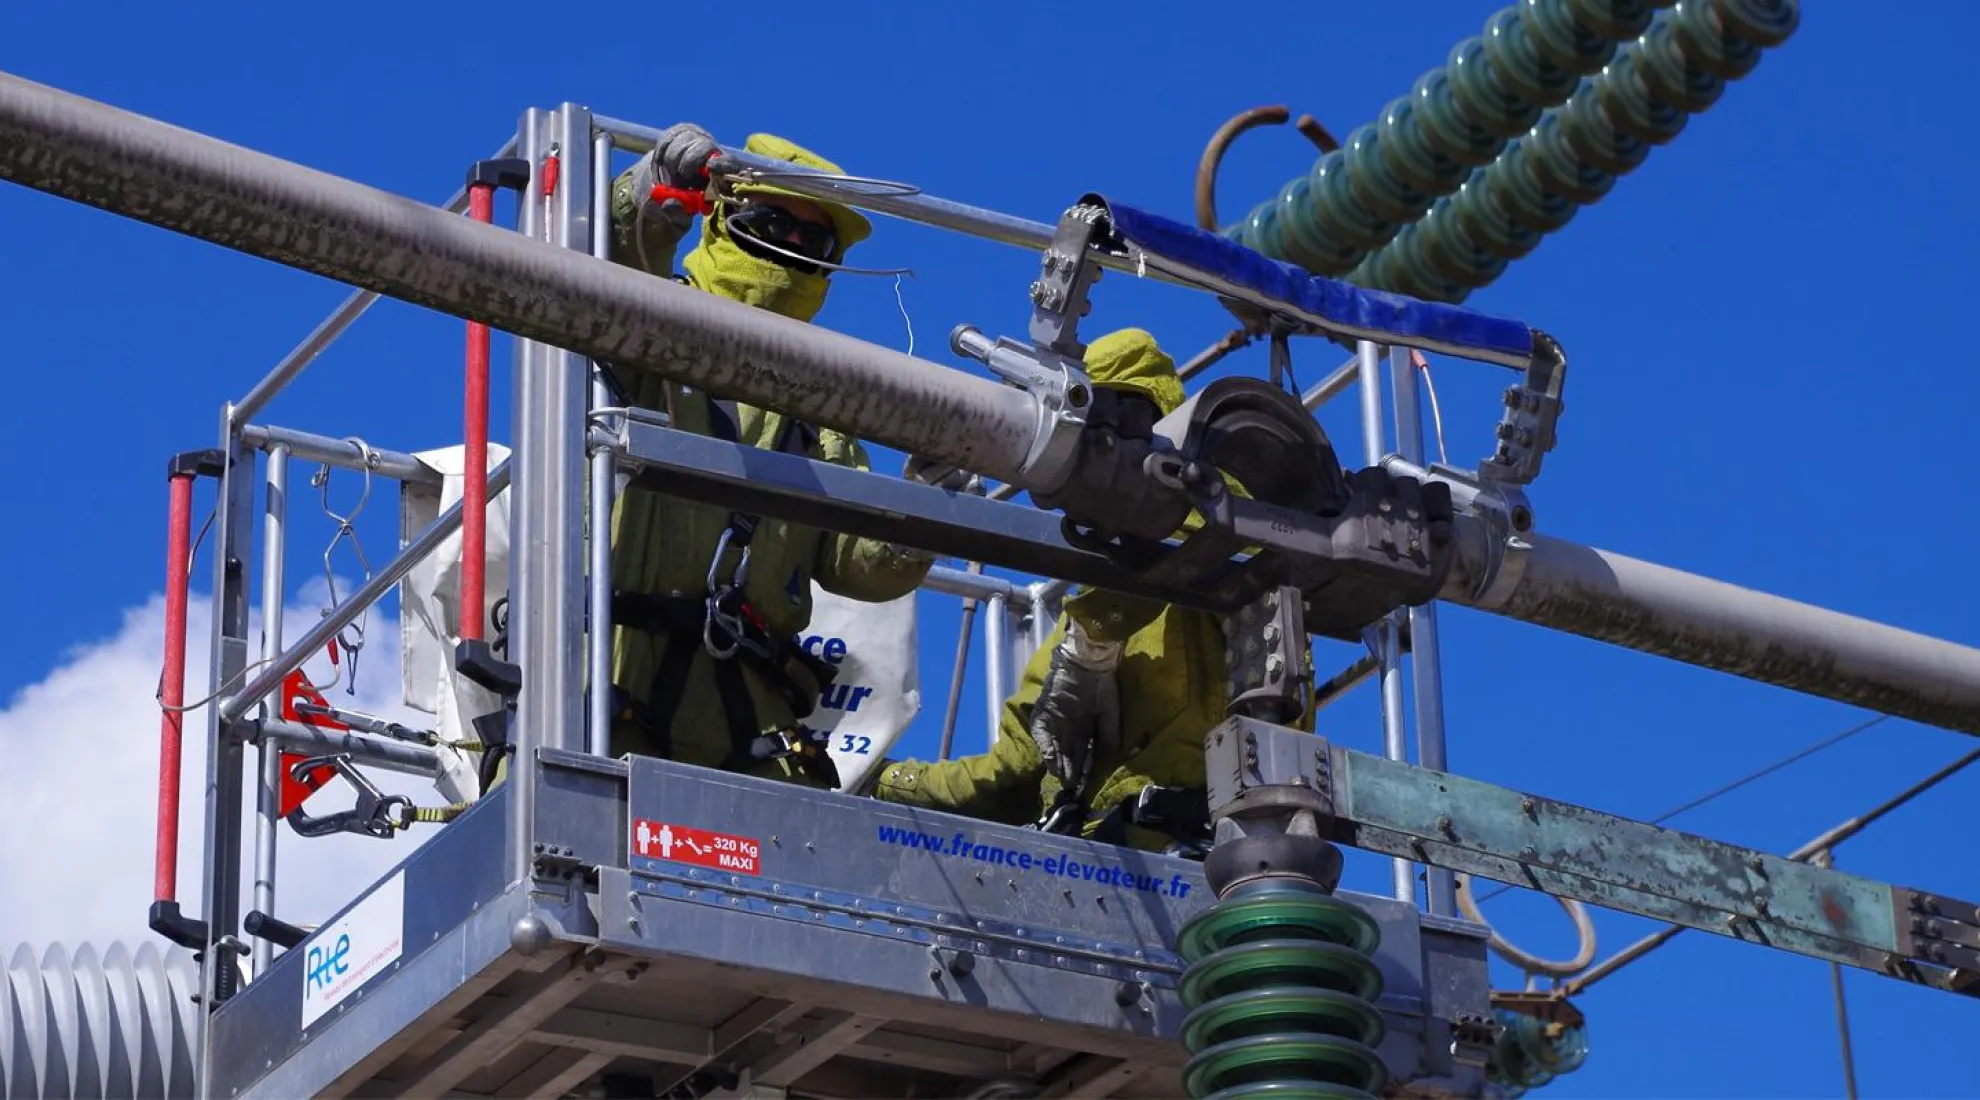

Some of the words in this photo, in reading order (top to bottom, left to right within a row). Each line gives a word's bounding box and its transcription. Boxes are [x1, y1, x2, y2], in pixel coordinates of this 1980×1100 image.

[793, 635, 847, 664] ce
[820, 684, 873, 712] ur
[839, 734, 872, 755] 32
[714, 837, 736, 852] 320
[740, 842, 758, 858] Kg
[719, 853, 752, 870] MAXI
[878, 825, 1191, 898] www.france-elevateur.fr
[307, 934, 350, 1001] Rte
